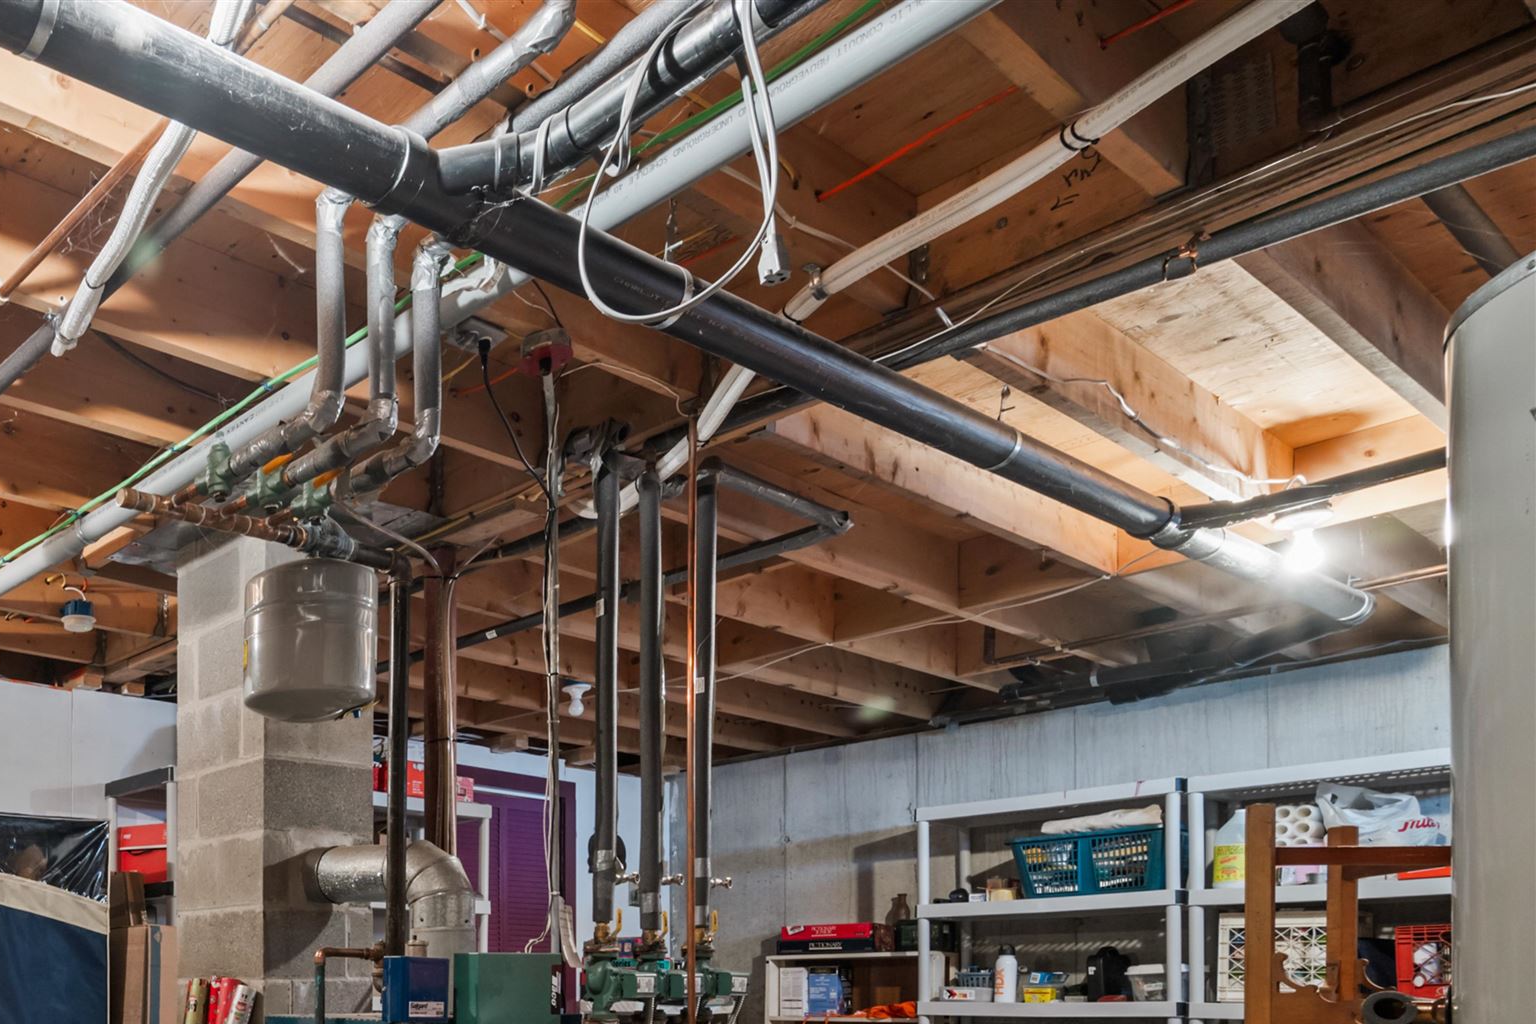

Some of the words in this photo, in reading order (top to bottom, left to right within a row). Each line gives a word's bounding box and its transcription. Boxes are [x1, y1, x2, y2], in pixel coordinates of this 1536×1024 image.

[835, 22, 884, 57] CONDUIT
[672, 115, 733, 156] UNDERGROUND
[628, 154, 668, 185] SCHEDULE
